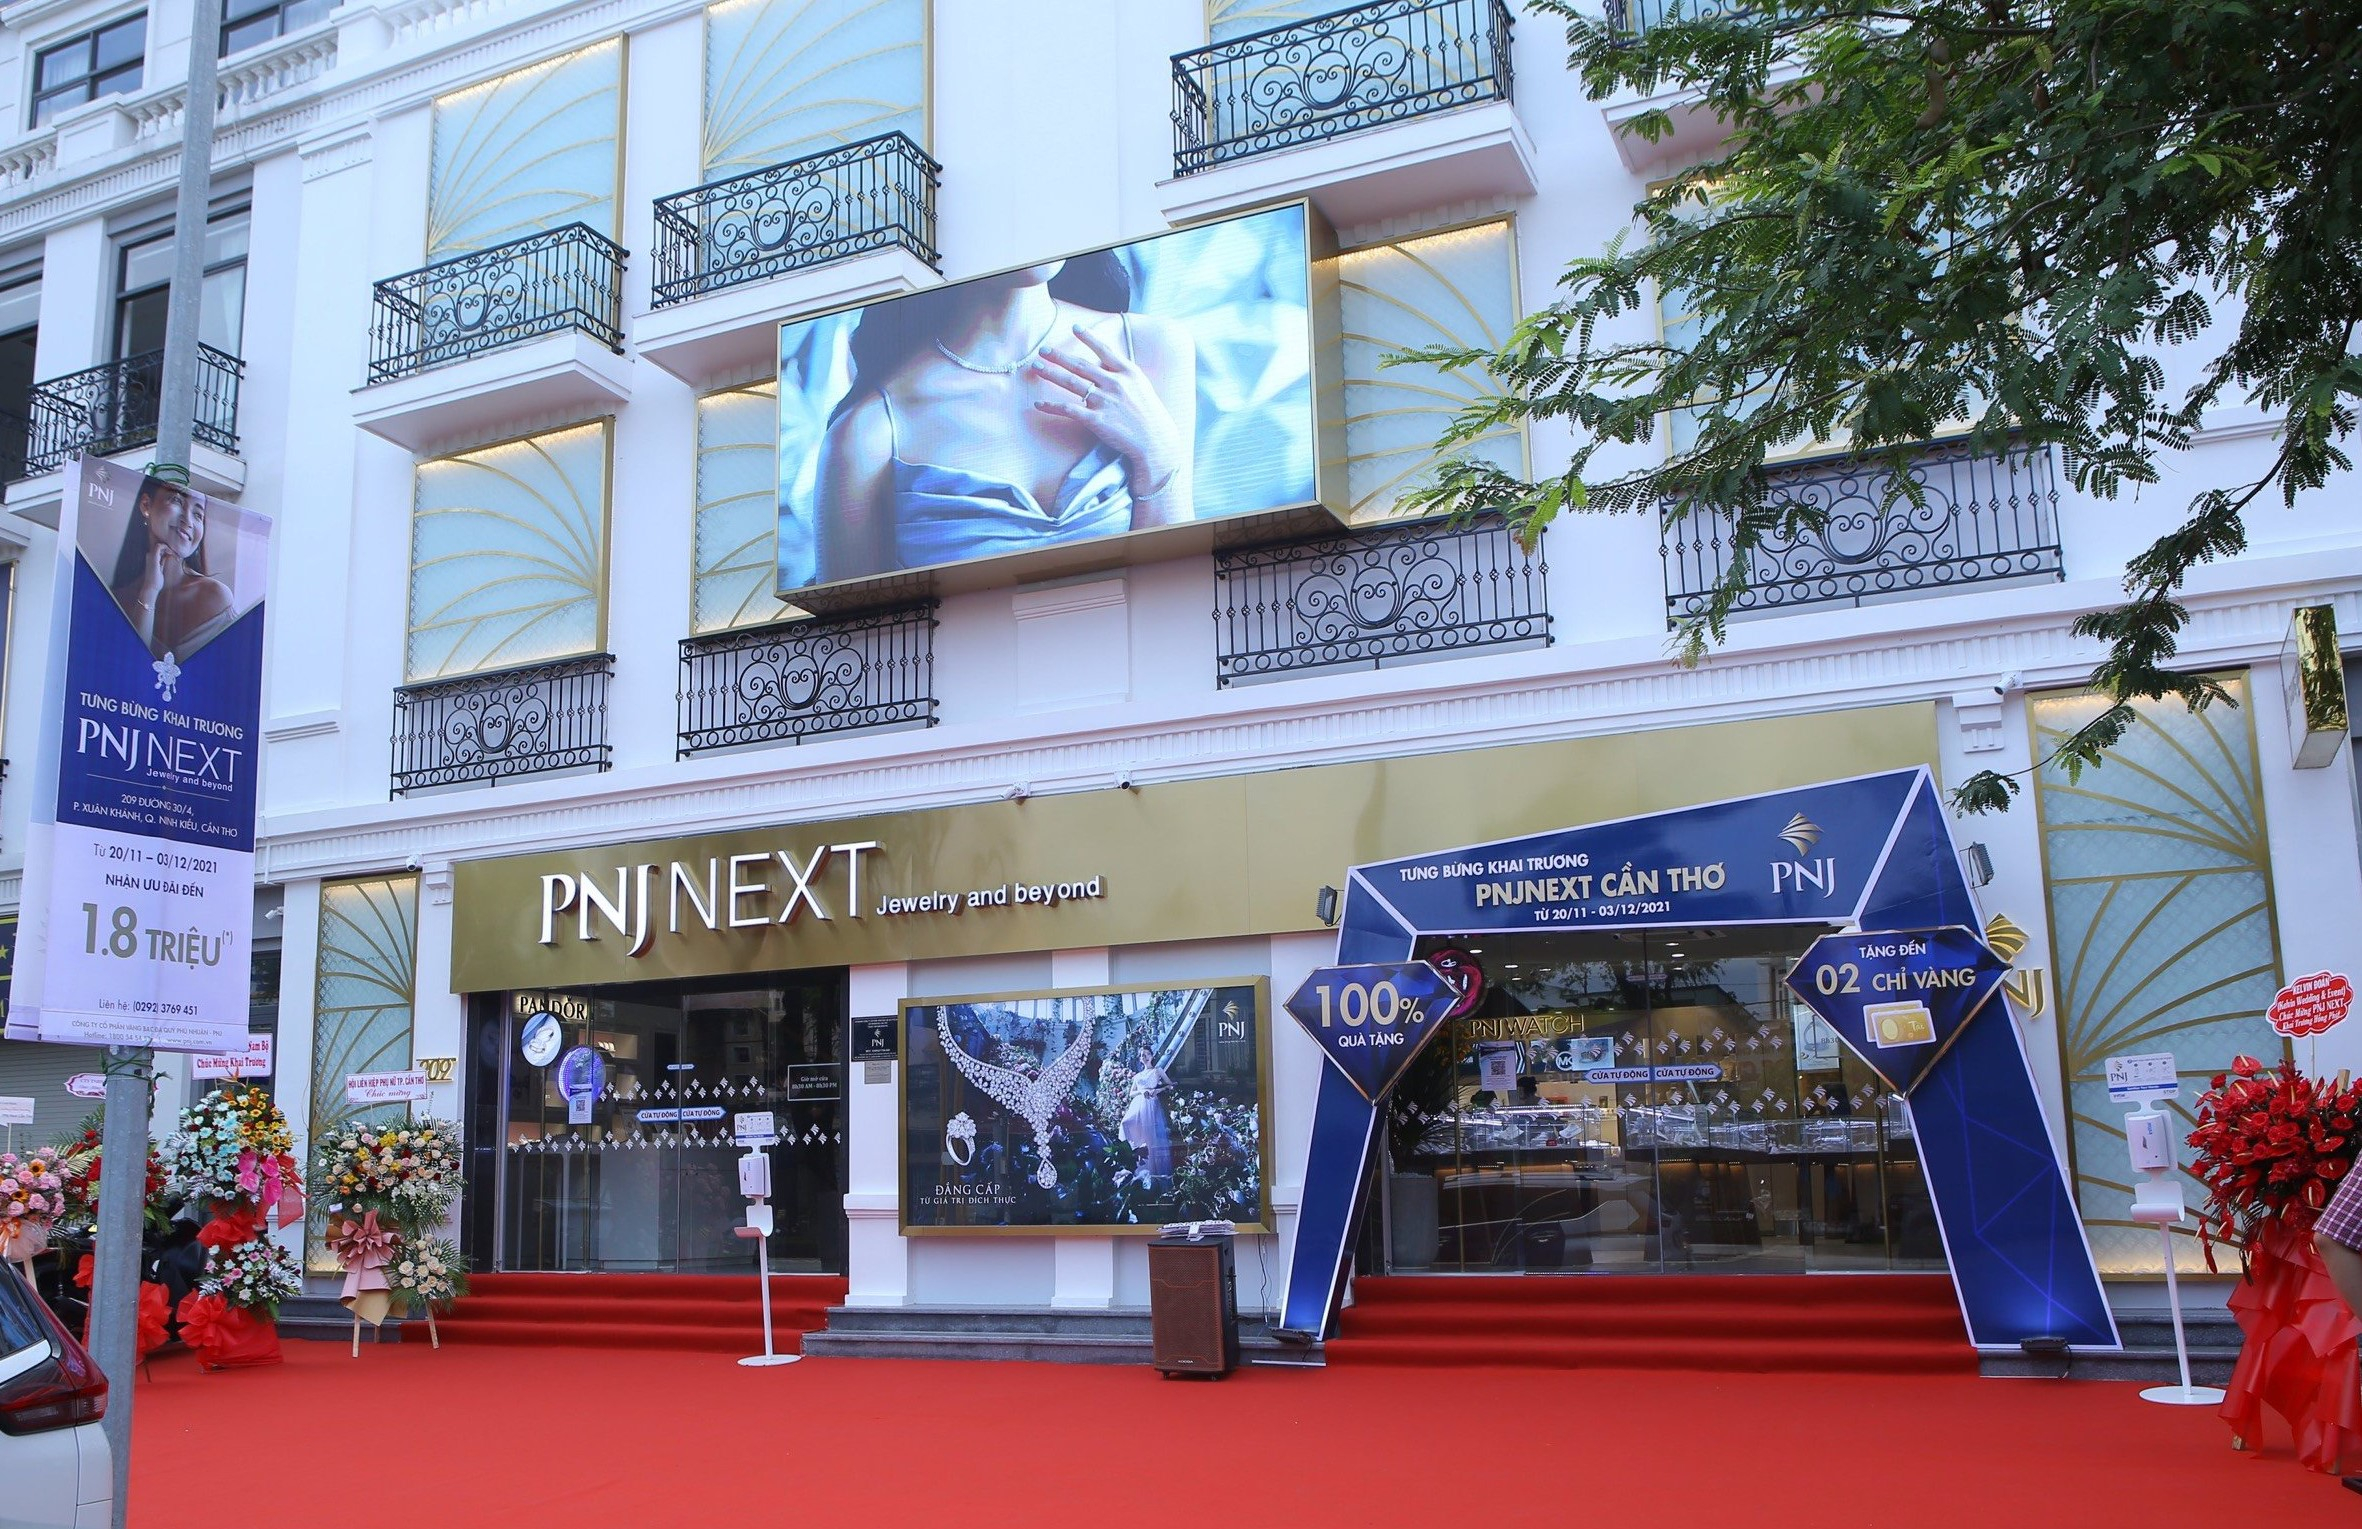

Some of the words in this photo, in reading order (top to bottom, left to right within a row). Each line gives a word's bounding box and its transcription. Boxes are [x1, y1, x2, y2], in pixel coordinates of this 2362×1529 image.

[89, 482, 114, 506] PNJ
[80, 692, 118, 712] TƯNG
[121, 700, 159, 722] BỪNG
[163, 710, 190, 729] KHAI
[193, 717, 244, 740] TRƯƠNG
[76, 717, 141, 772] PNJ
[148, 732, 242, 783] NEXT
[146, 768, 180, 784] Jewelry
[182, 776, 199, 786] and
[202, 779, 233, 792] beyond
[121, 794, 137, 805] 209
[138, 796, 172, 811] ĐƯỜNG
[73, 801, 80, 811] P.
[82, 802, 109, 816] XUÂN
[109, 807, 143, 822] KHÁNH,
[144, 814, 156, 824] Q.
[159, 816, 178, 827] NINH
[221, 826, 238, 838] THƠ
[94, 843, 106, 857] Từ
[109, 845, 142, 863] 20/11
[156, 852, 218, 874] 03/12/2021
[1400, 866, 1439, 882] TƯNG
[1443, 859, 1485, 879] BỪNG
[1488, 858, 1524, 876] KHAI
[1526, 852, 1590, 871] TRƯƠNG
[105, 872, 140, 892] NHẬN
[143, 876, 161, 892] ƯU
[163, 878, 179, 896] ĐÃI
[182, 880, 204, 899] ĐẾN
[1476, 875, 1593, 907] PNJNEXT
[1600, 861, 1660, 897] CẦN
[1666, 862, 1727, 893] THƠ
[1770, 857, 1835, 899] PNJ
[538, 864, 660, 959] PNJ
[669, 840, 886, 934] NEXT
[876, 887, 961, 918] Jewelry
[967, 885, 1007, 909] and
[1014, 874, 1103, 907] beyond
[1534, 907, 1549, 922] TỪ
[1552, 907, 1588, 921] 20/11
[1599, 900, 1672, 918] 03/12/2021
[82, 902, 138, 959] 1.8
[1858, 944, 1897, 961] TẶNG
[1898, 939, 1927, 956] ĐẾN
[1815, 962, 1861, 996] 02
[1872, 966, 1908, 992] CHỈ
[1913, 966, 1977, 989] VÀNG
[2293, 982, 2313, 995] KELVIN
[1316, 981, 1425, 1028] 100%
[2003, 969, 2045, 1020] NJ
[2296, 993, 2320, 1006] Wedding
[2321, 991, 2326, 1000] &
[2327, 986, 2346, 999] Event)
[99, 999, 115, 1010] Liên
[117, 999, 130, 1013] hệ:
[133, 1000, 159, 1014] (0292)
[160, 1003, 181, 1015] 3769
[183, 1005, 198, 1016] 451
[520, 995, 588, 1020] PANDOR
[2278, 1011, 2293, 1022] Chúc
[2312, 1001, 2326, 1014] PNJ
[2326, 998, 2344, 1010] NEXT
[1218, 1021, 1245, 1040] PNJ
[1470, 1020, 1504, 1040] PNJ
[1506, 1015, 1585, 1038] WATCH
[2282, 1020, 2294, 1030] Khai
[109, 1033, 125, 1041] 1800
[871, 1038, 885, 1048] PNJ
[1338, 1032, 1367, 1048] QUÀ
[1370, 1031, 1405, 1048] TẶNG
[197, 1058, 212, 1069] Chúc
[230, 1057, 244, 1067] Khai
[1655, 1066, 1674, 1078] CỬA
[1674, 1066, 1688, 1079] TỰ
[1688, 1065, 1715, 1077] ĐỘNG
[357, 1078, 368, 1088] LIÊN
[368, 1077, 379, 1089] HIỆP
[379, 1077, 389, 1089] PHỤ
[1591, 1070, 1609, 1080] CỬA
[1609, 1070, 1623, 1081] TỰ
[1623, 1068, 1649, 1080] ĐỘNG
[2110, 1072, 2128, 1082] PNJ
[641, 1111, 653, 1119] CỬA
[652, 1111, 661, 1120] TỰ
[660, 1110, 678, 1119] ĐỘNG
[682, 1109, 695, 1118] CỬA
[695, 1109, 703, 1118] TỰ
[703, 1108, 721, 1117] ĐỘNG
[935, 1181, 971, 1196] ĐẲNG
[975, 1181, 1001, 1195] CẤP
[933, 1196, 949, 1205] GIÁ
[968, 1195, 990, 1204] ĐÍCH
[993, 1195, 1017, 1205] THỰC
